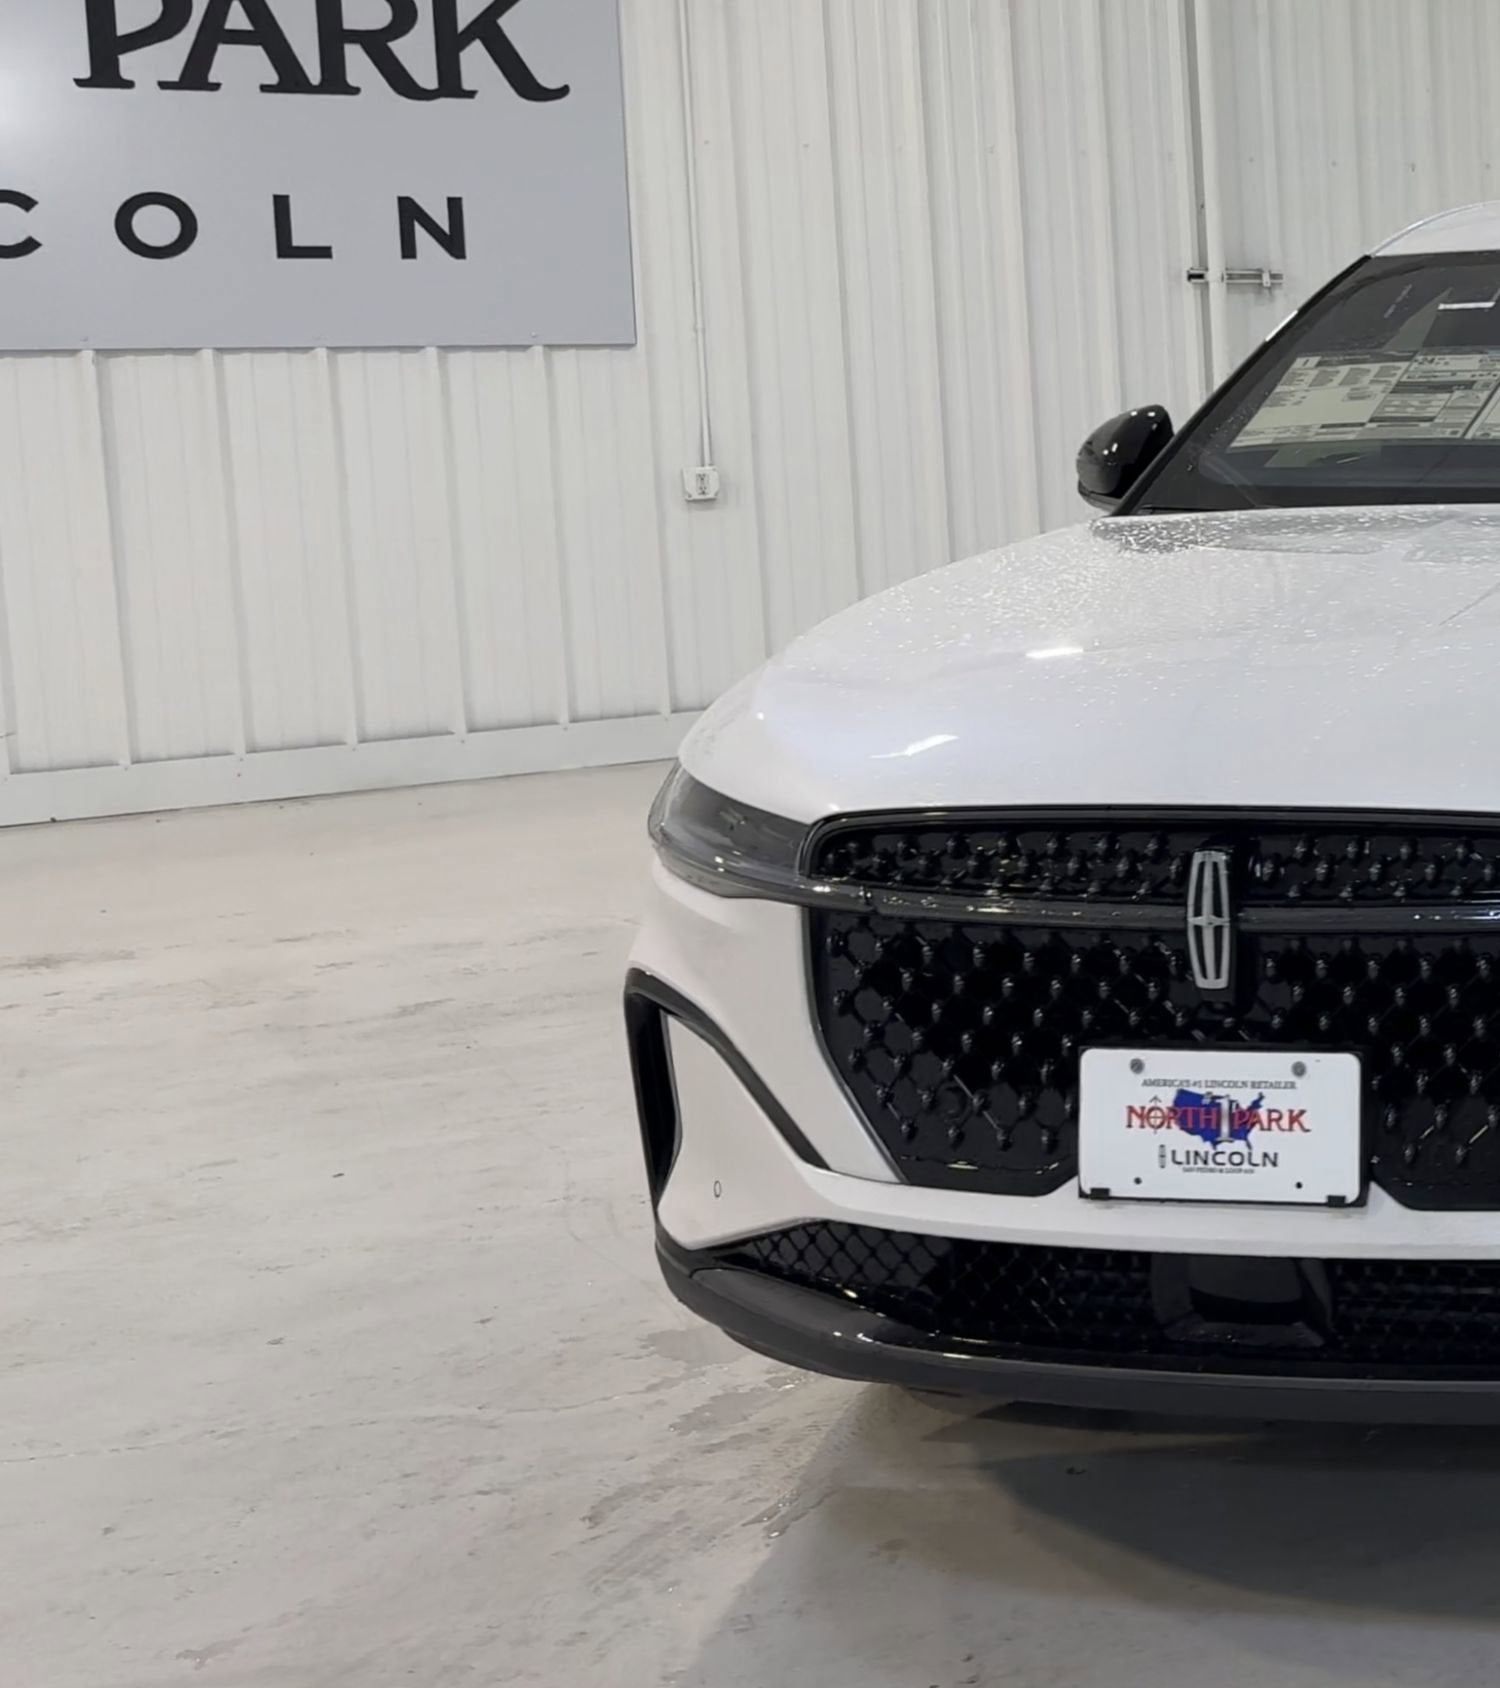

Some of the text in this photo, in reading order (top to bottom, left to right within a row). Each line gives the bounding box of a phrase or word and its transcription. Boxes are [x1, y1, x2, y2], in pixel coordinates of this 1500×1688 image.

[73, 0, 571, 102] PARK
[1204, 1080, 1248, 1090] LINCOLN
[1251, 1081, 1296, 1090] RETAILER
[1125, 1105, 1311, 1132] NORTH PARK
[1170, 1149, 1279, 1168] LINCOLN
